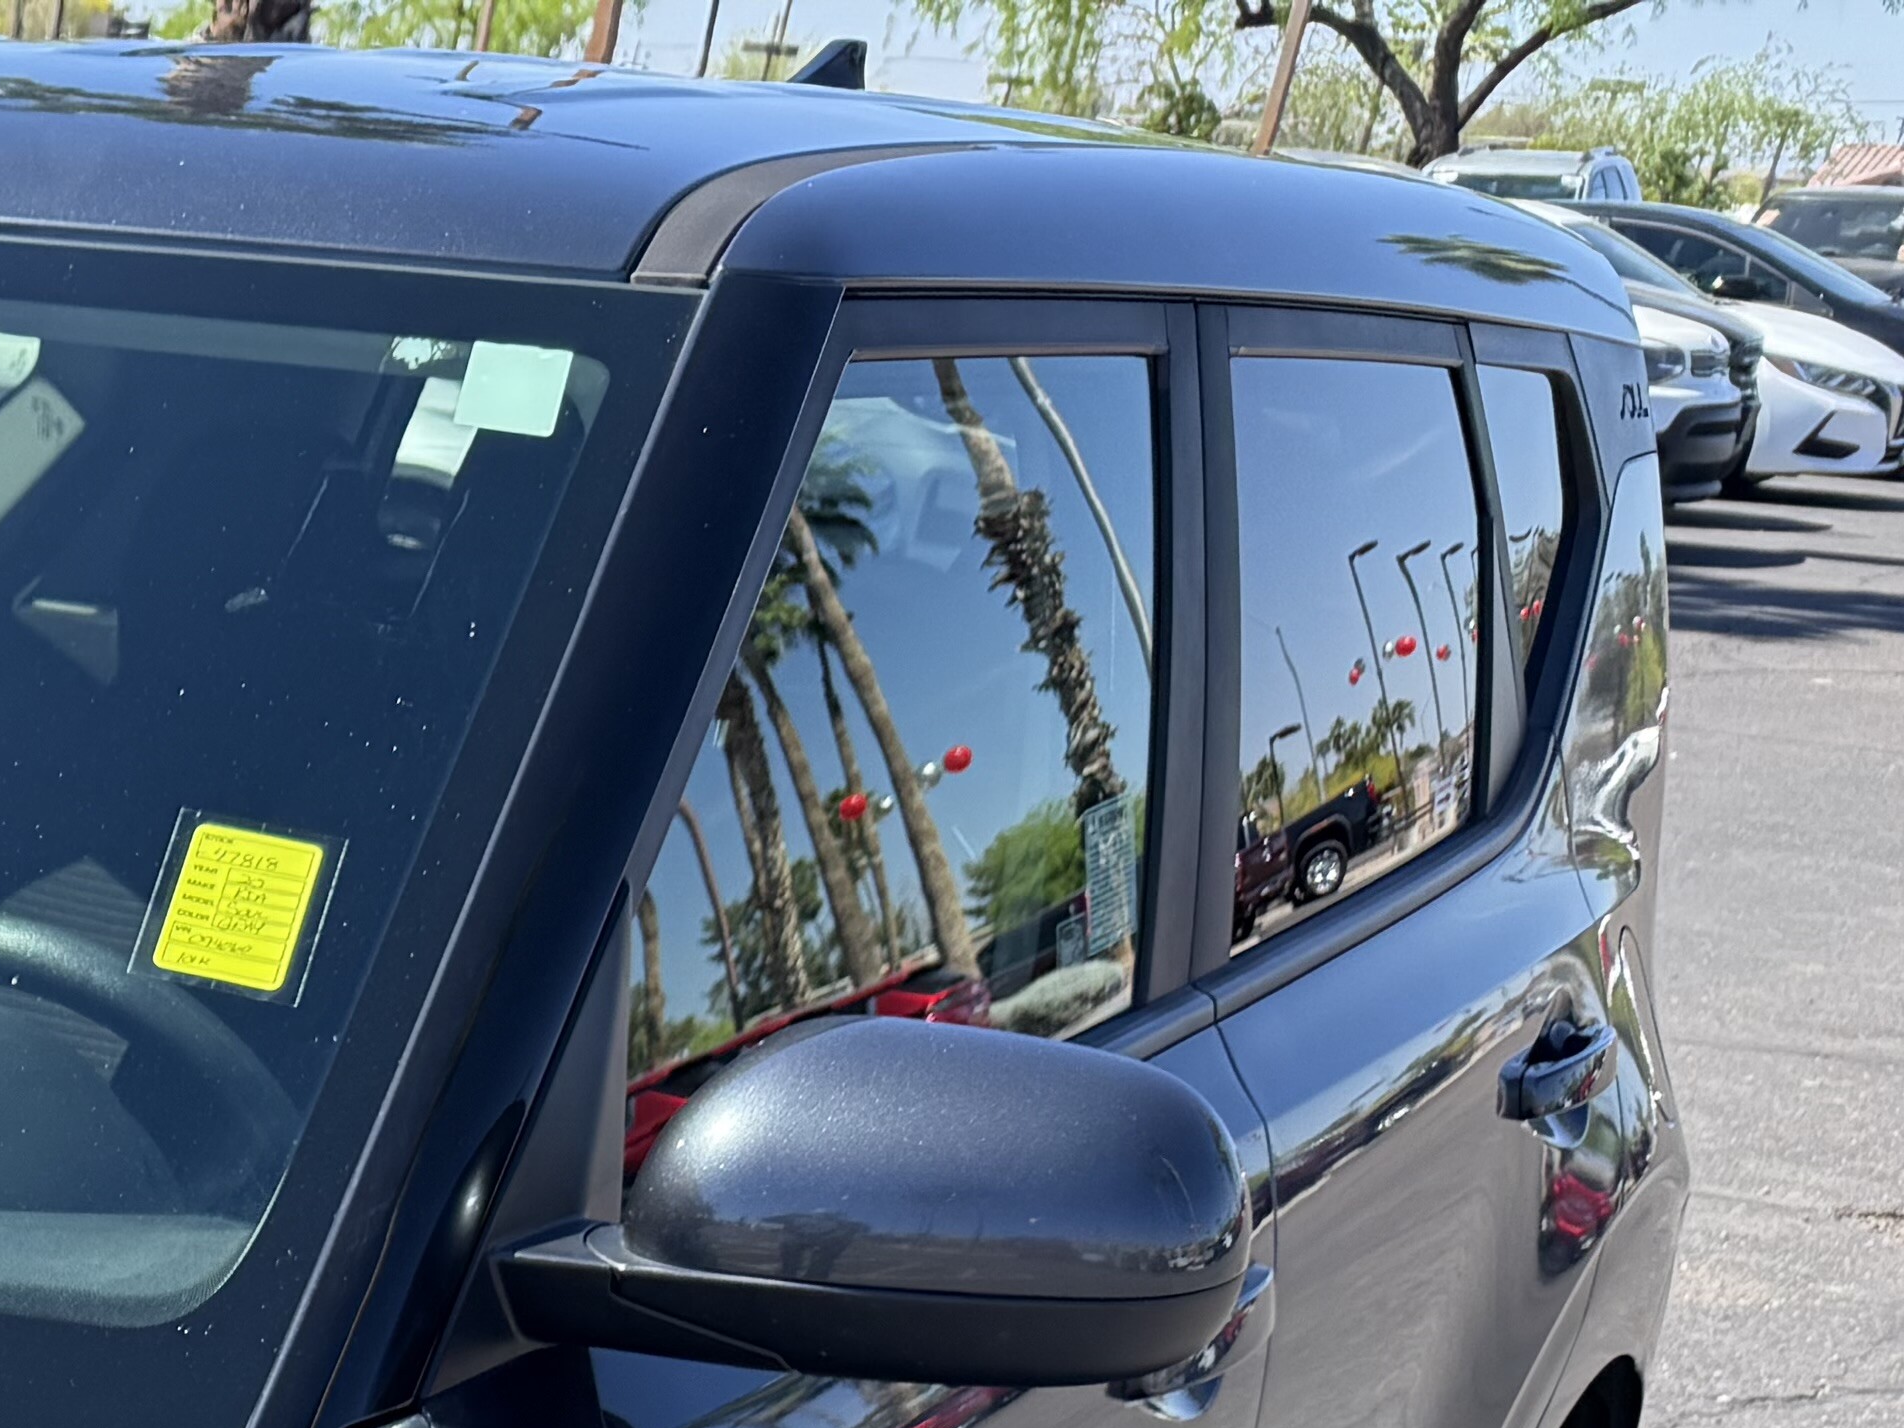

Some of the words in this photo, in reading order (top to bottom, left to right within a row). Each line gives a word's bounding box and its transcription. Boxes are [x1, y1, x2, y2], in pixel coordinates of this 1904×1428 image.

[193, 863, 218, 875] YEAR
[187, 878, 216, 891] MAKE
[182, 893, 215, 907] MODEL
[177, 908, 210, 922] COLOR
[175, 924, 192, 935] VIN
